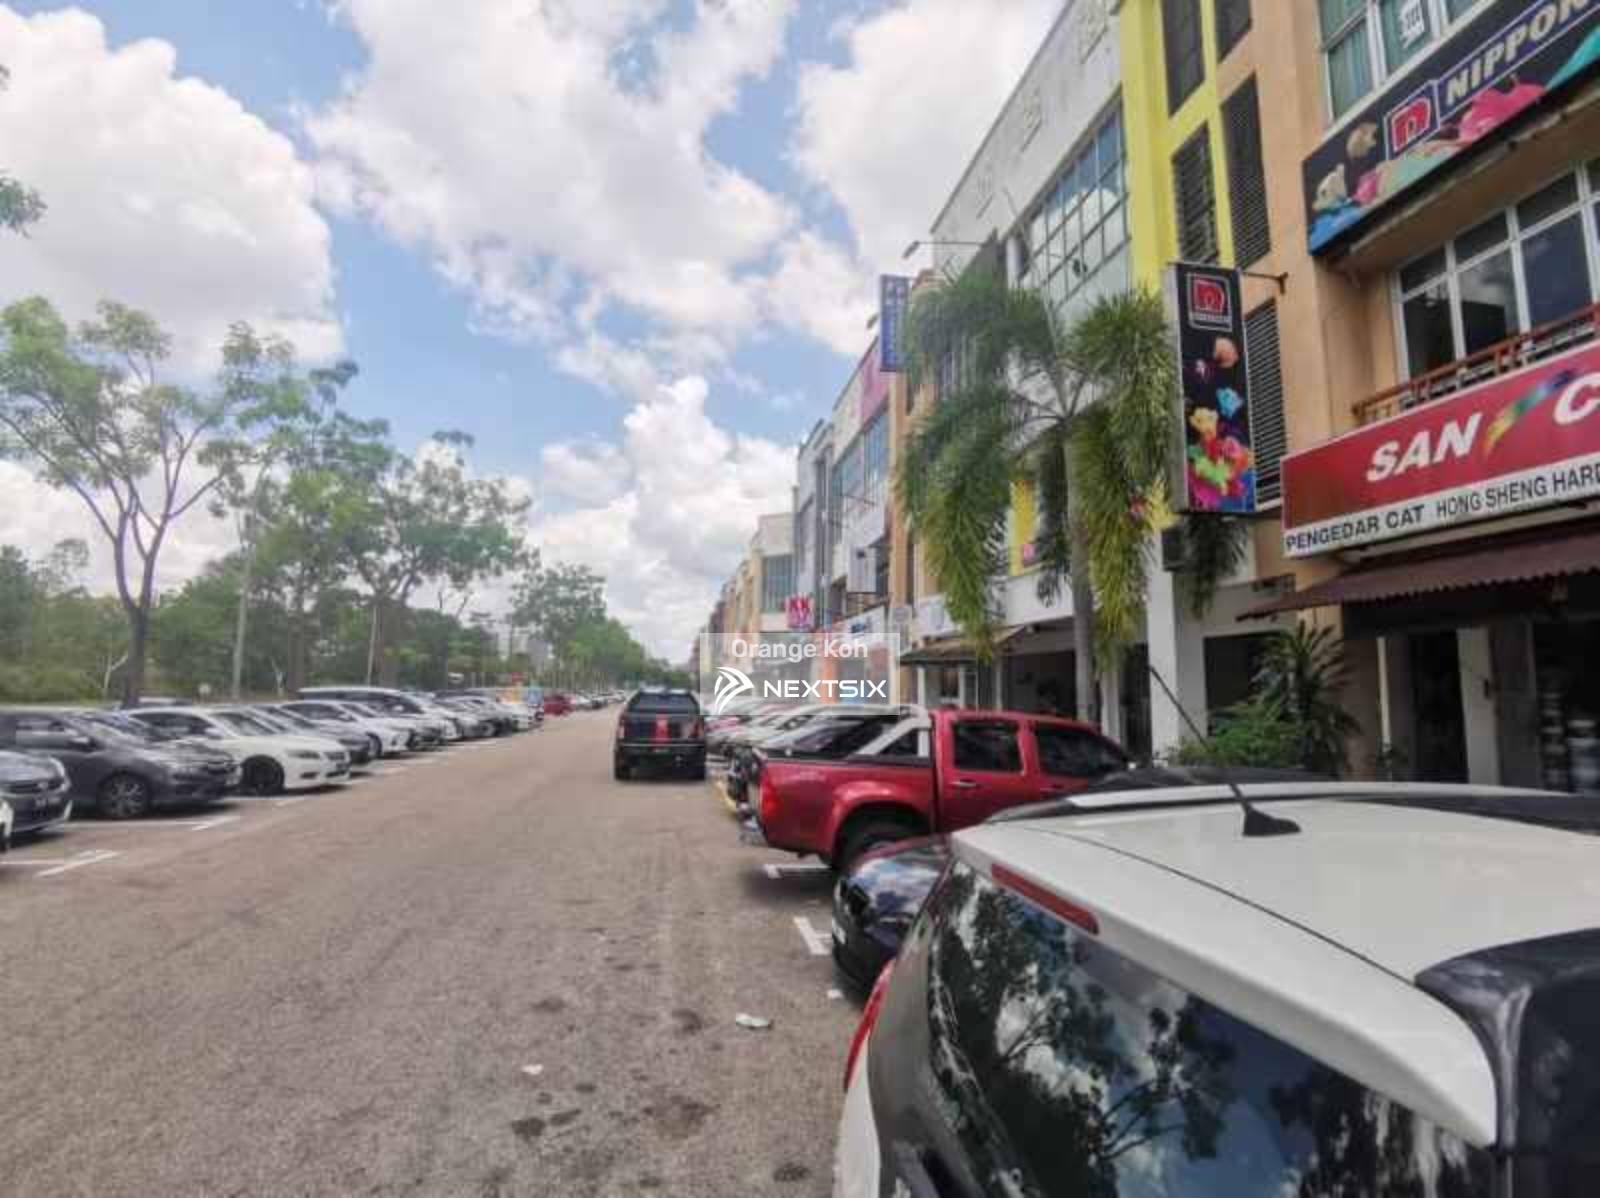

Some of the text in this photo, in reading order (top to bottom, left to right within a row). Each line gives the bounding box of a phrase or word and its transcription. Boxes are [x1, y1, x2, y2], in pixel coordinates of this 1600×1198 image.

[1367, 412, 1483, 481] SAN
[1285, 515, 1380, 551] PENGEDAR
[1386, 504, 1425, 529] CAT
[1436, 490, 1482, 517] HONG
[1485, 475, 1548, 508] SHENG
